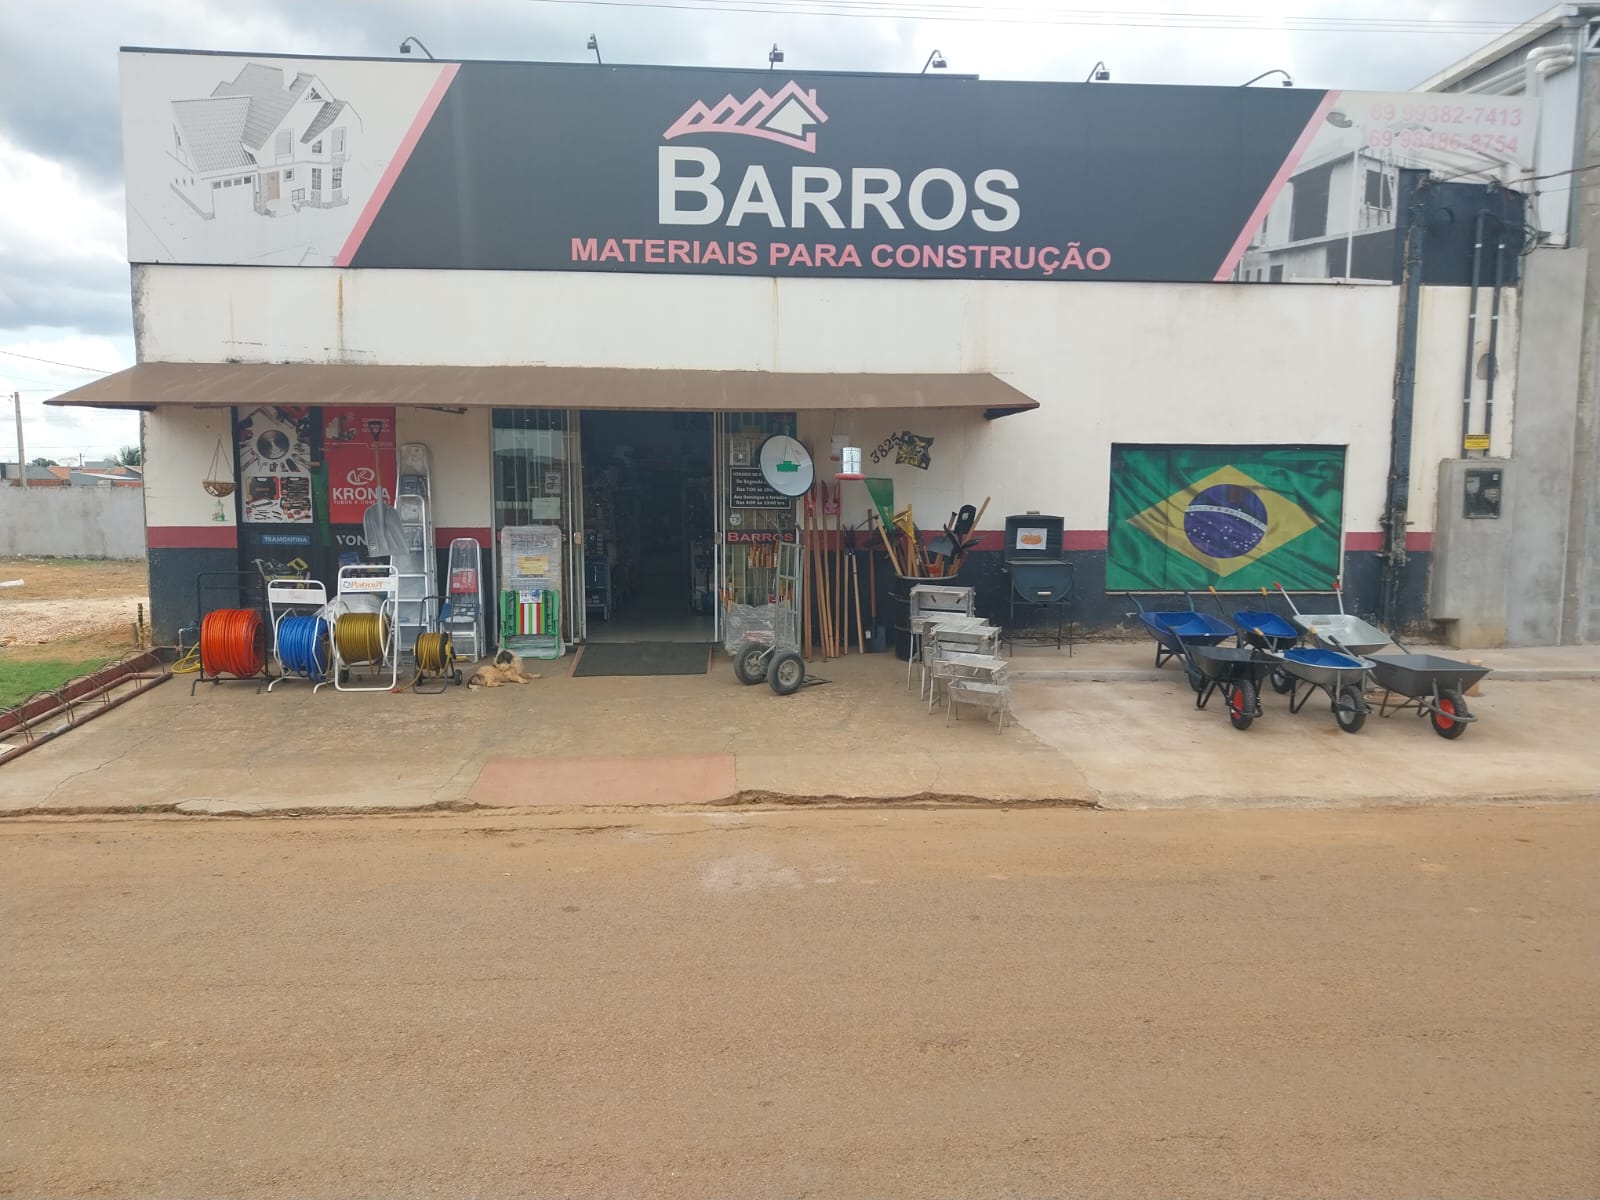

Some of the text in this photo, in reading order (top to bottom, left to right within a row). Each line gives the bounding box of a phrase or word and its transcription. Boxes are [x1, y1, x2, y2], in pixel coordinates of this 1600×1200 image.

[1369, 130, 1393, 147] 69
[658, 145, 1021, 232] BARROS
[571, 237, 1111, 275] MATERIAIS PARA CONSTRUÇÃO
[870, 432, 900, 463] 3825
[332, 487, 391, 501] KRONA
[264, 536, 308, 544] TRAMONTINA
[727, 532, 794, 542] BARROS
